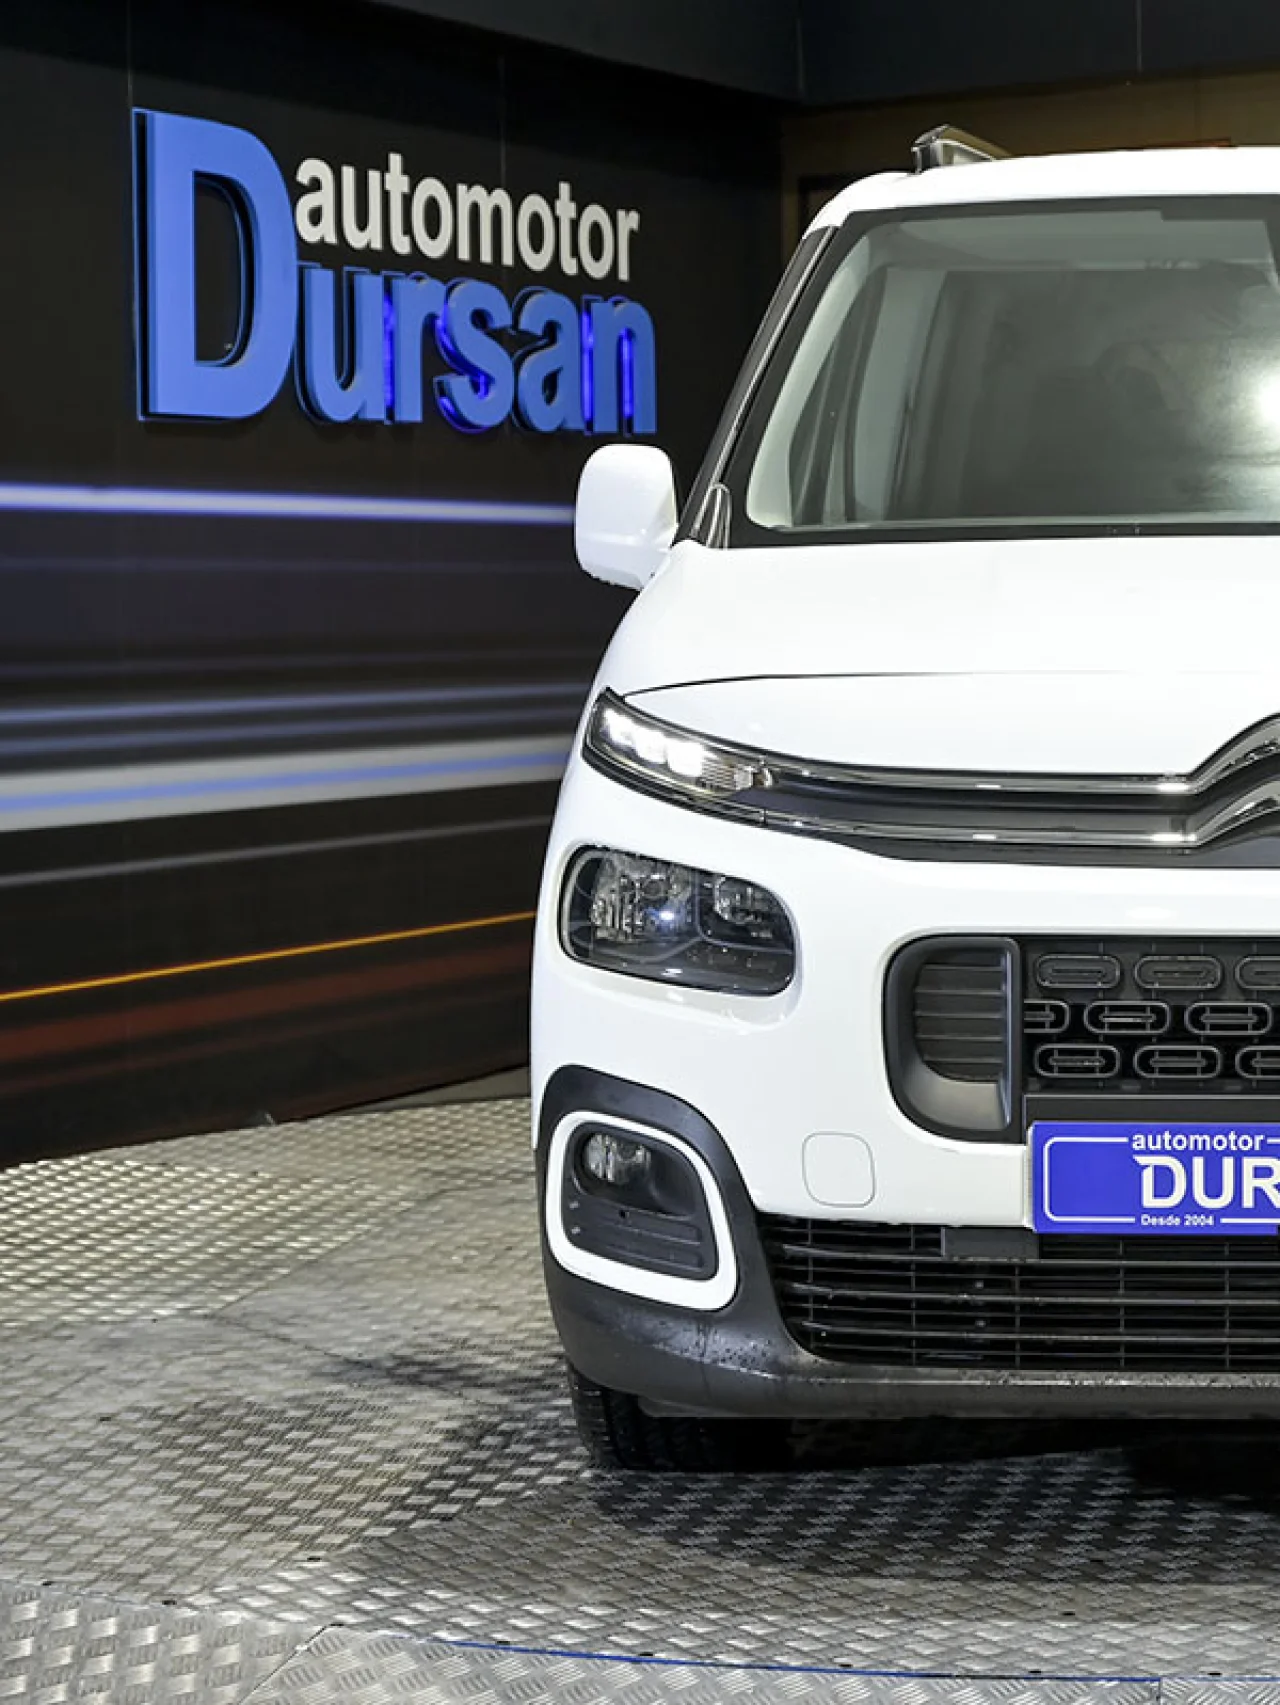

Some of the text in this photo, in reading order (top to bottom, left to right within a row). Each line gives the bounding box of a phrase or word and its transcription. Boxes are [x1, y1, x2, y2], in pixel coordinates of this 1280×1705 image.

[296, 152, 640, 281] automotor
[132, 107, 657, 435] Dursan
[1132, 1130, 1263, 1151] automotor
[1141, 1213, 1213, 1226] Desde 2004
